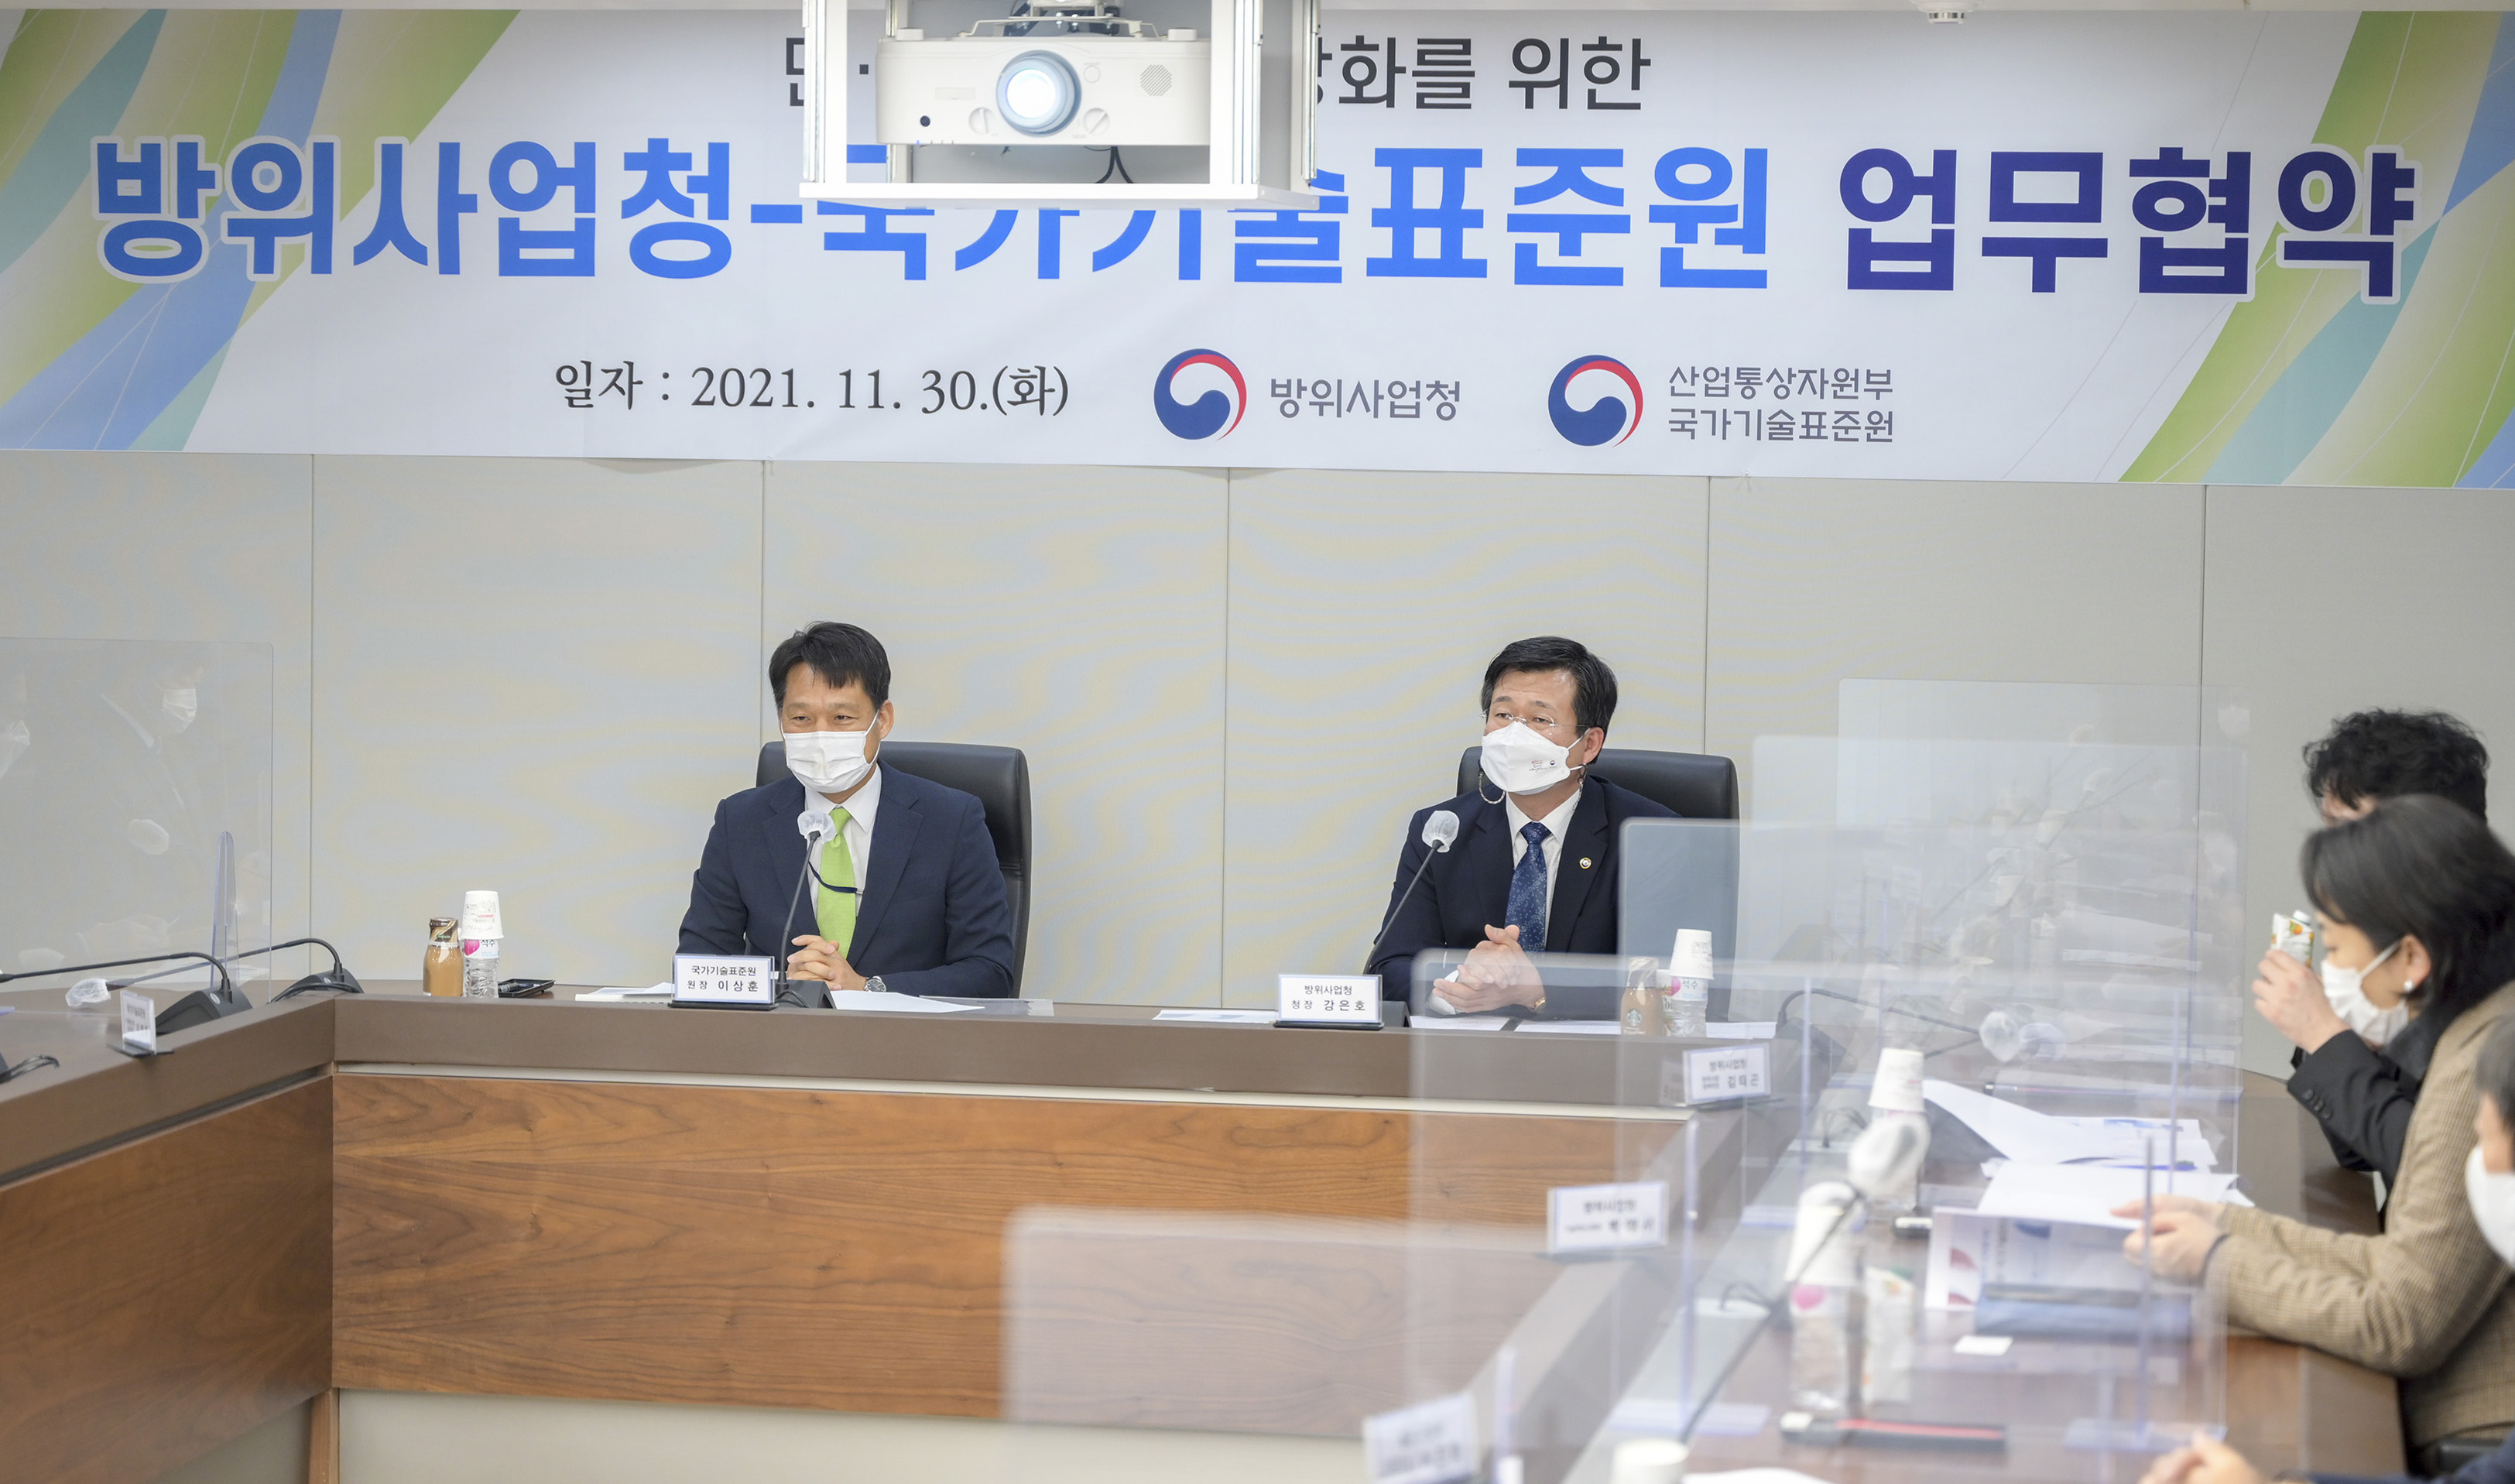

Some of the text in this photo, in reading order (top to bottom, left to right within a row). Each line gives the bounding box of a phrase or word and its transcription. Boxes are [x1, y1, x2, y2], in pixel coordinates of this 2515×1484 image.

[1509, 36, 1651, 110] 위한
[1839, 146, 2415, 297] 업무협약
[555, 360, 644, 410] 일자
[691, 367, 815, 408] 2021.
[838, 368, 902, 410] 11.
[921, 365, 1068, 416] 30.(화)
[1270, 378, 1461, 421] 방위사업청
[1669, 366, 1893, 400] 산업통상자원부
[1668, 408, 1893, 443] 국가기술표준원
[691, 965, 756, 976] 국가기술표준원
[1304, 985, 1352, 996] 방위사업청
